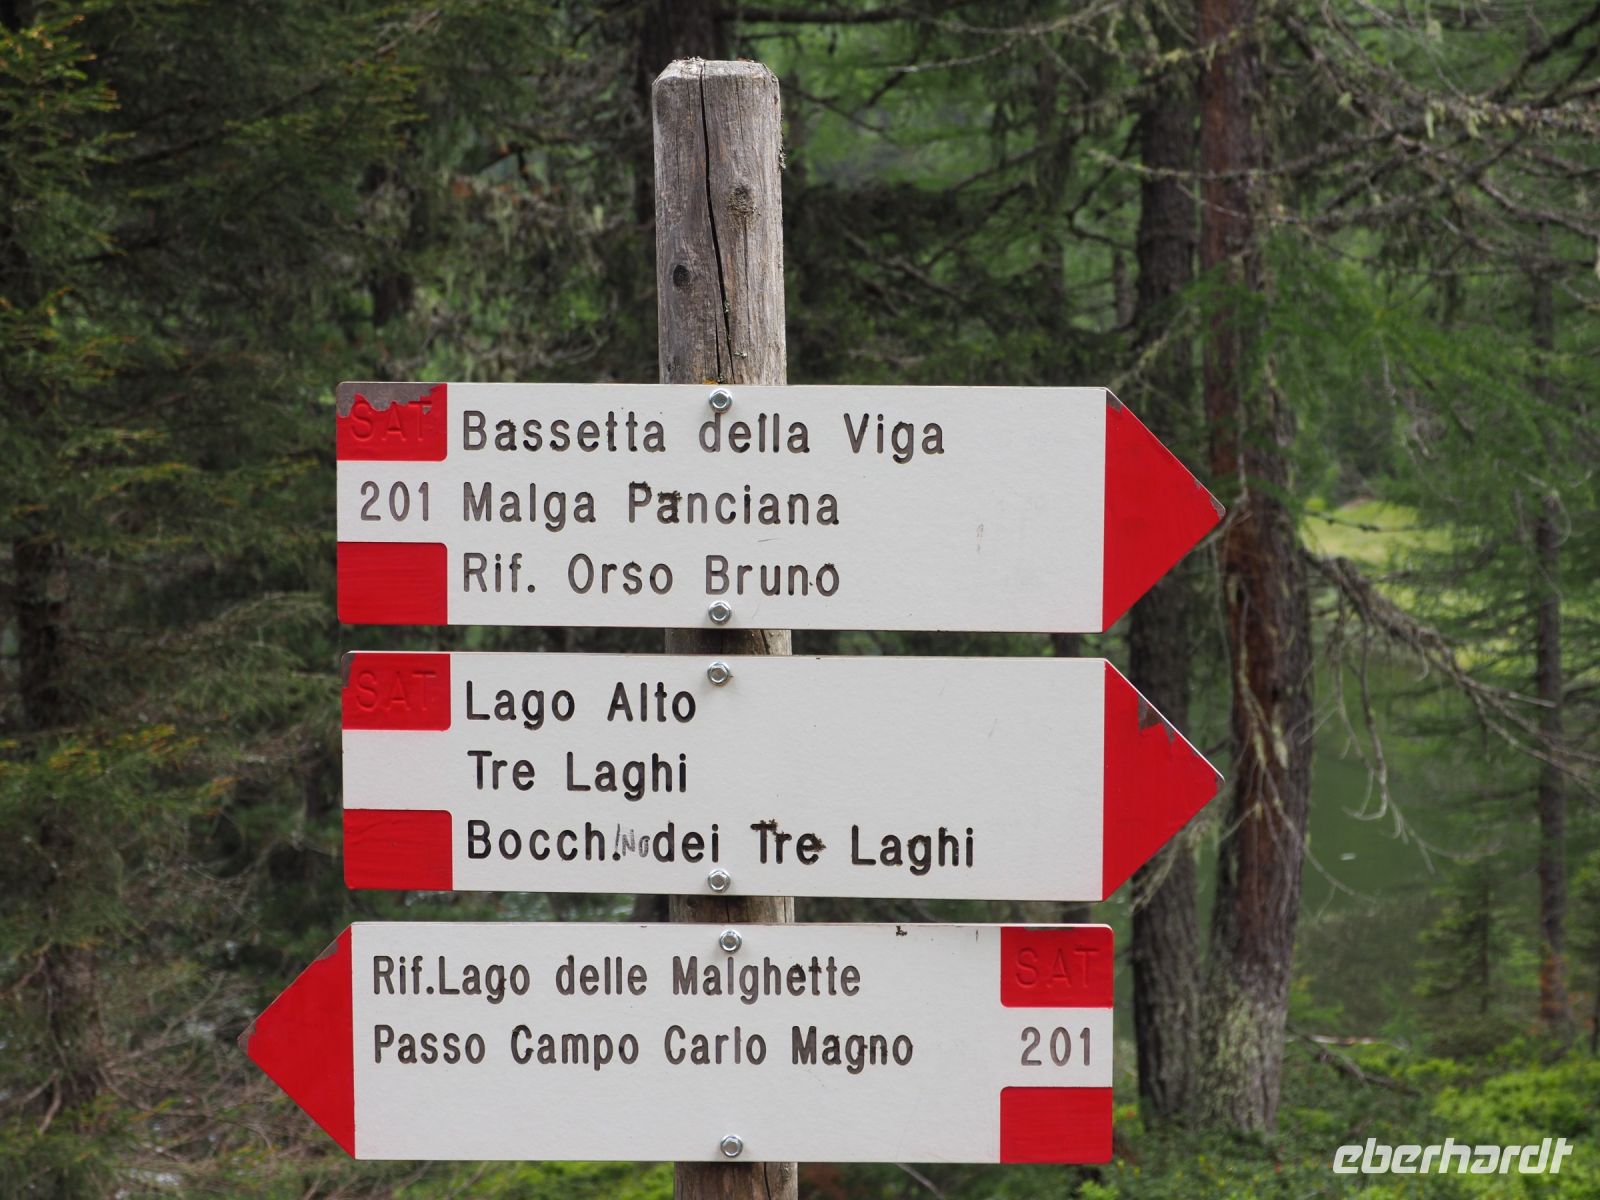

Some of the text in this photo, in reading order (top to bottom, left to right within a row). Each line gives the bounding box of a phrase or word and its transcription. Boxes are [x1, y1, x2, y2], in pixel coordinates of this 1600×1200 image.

[463, 410, 945, 464] Bassetta della Viga
[360, 480, 430, 521] 201
[463, 481, 840, 533] Malga Panciana
[463, 552, 840, 597] Rif. Orso Bruno
[356, 669, 437, 712] SAT
[466, 680, 696, 731] Lago Alto
[467, 750, 687, 802] Tre Laghi
[652, 821, 719, 863] dei
[751, 819, 827, 866] Tre
[851, 825, 974, 876] Laghi
[555, 954, 648, 996] delle
[672, 955, 861, 1005] Malghette
[1016, 946, 1099, 988] SAT
[374, 1024, 914, 1074] Passo Campo Carlo Magno
[1020, 1026, 1092, 1066] 201
